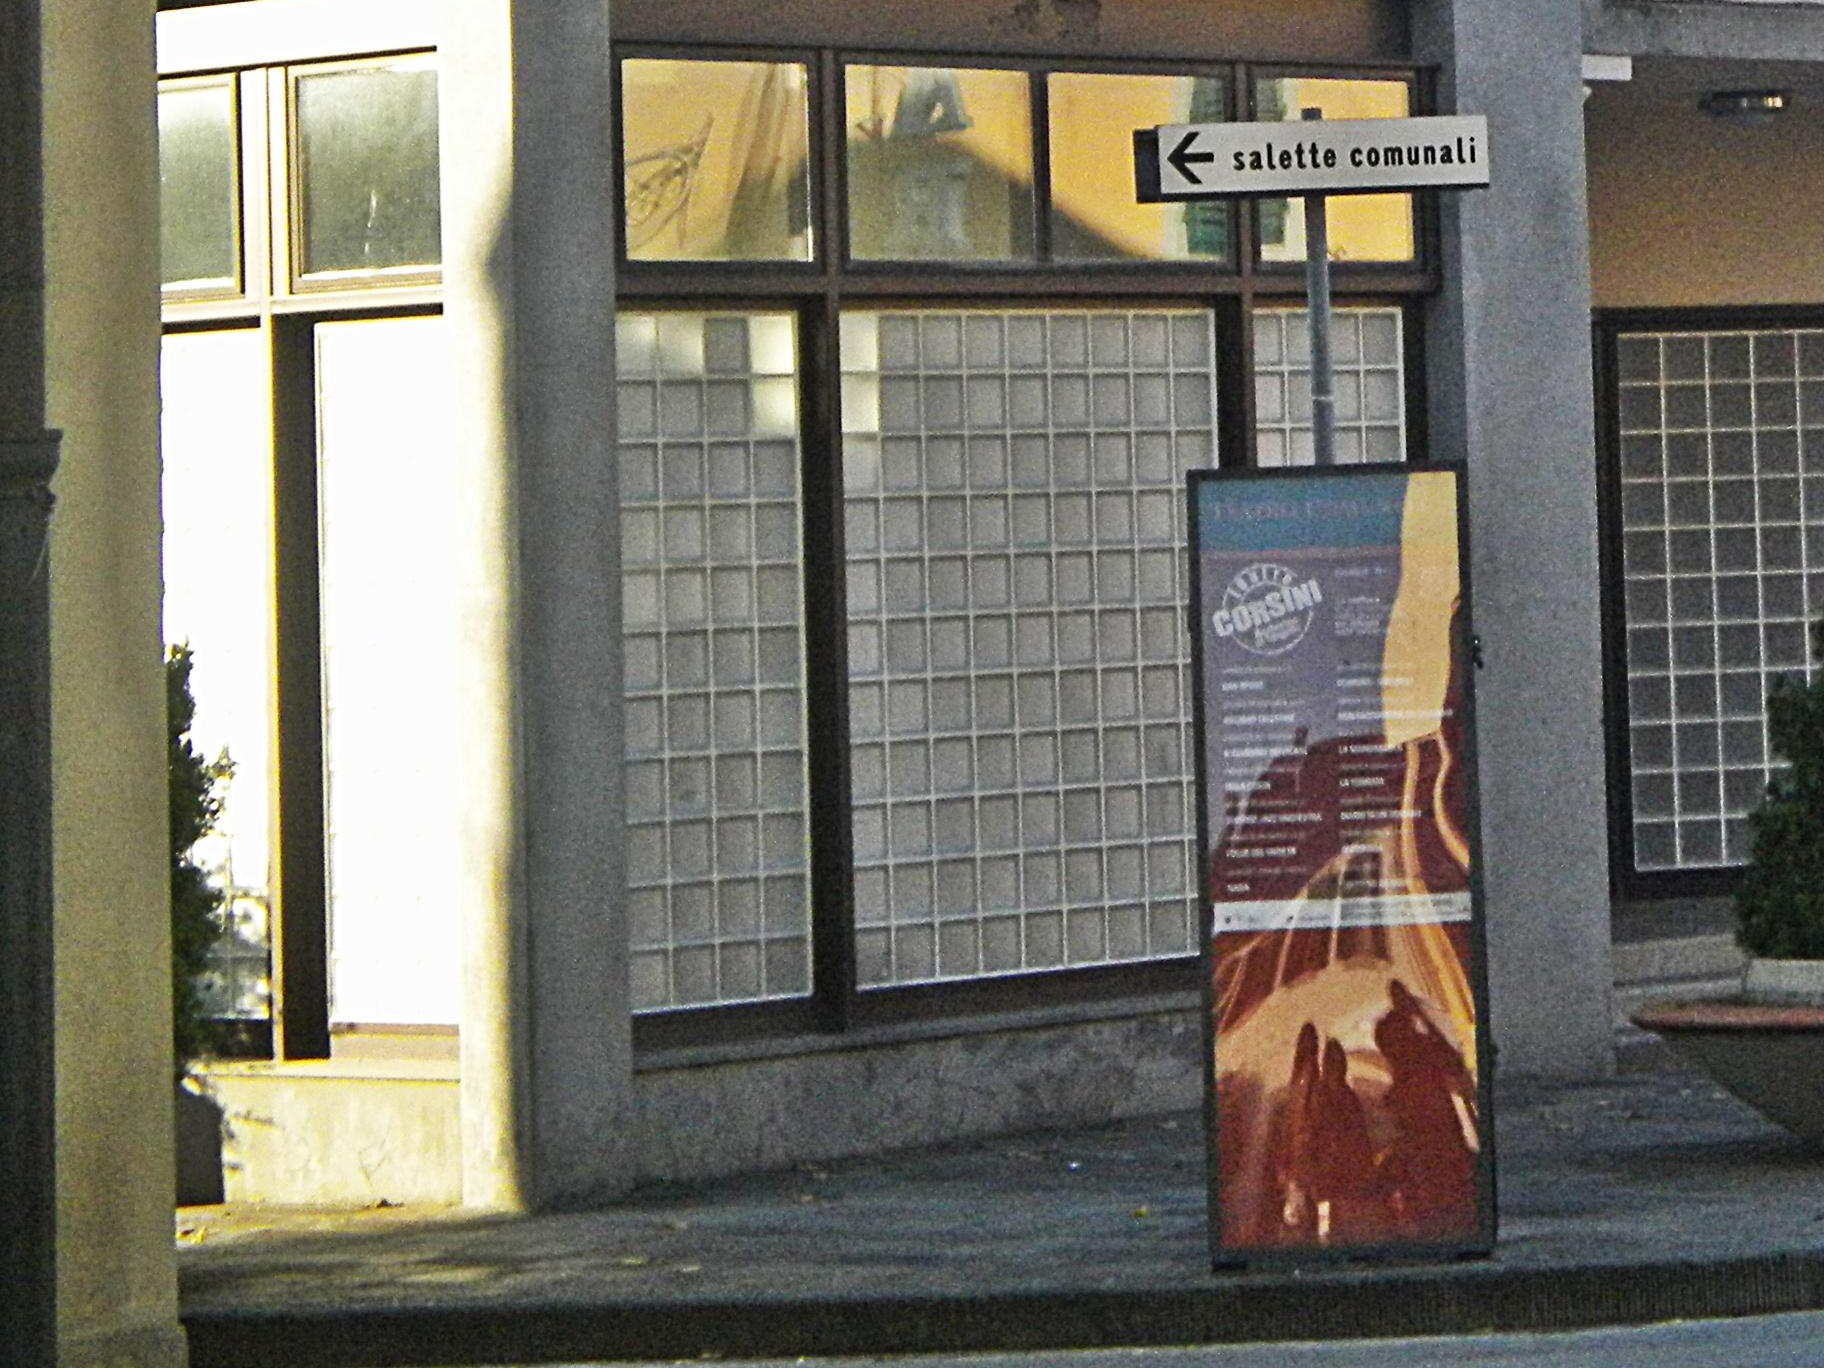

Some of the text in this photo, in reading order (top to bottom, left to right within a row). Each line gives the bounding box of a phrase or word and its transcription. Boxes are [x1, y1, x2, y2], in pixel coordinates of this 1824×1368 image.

[1232, 136, 1477, 171] salette comunali
[1211, 576, 1323, 638] CORSINI
